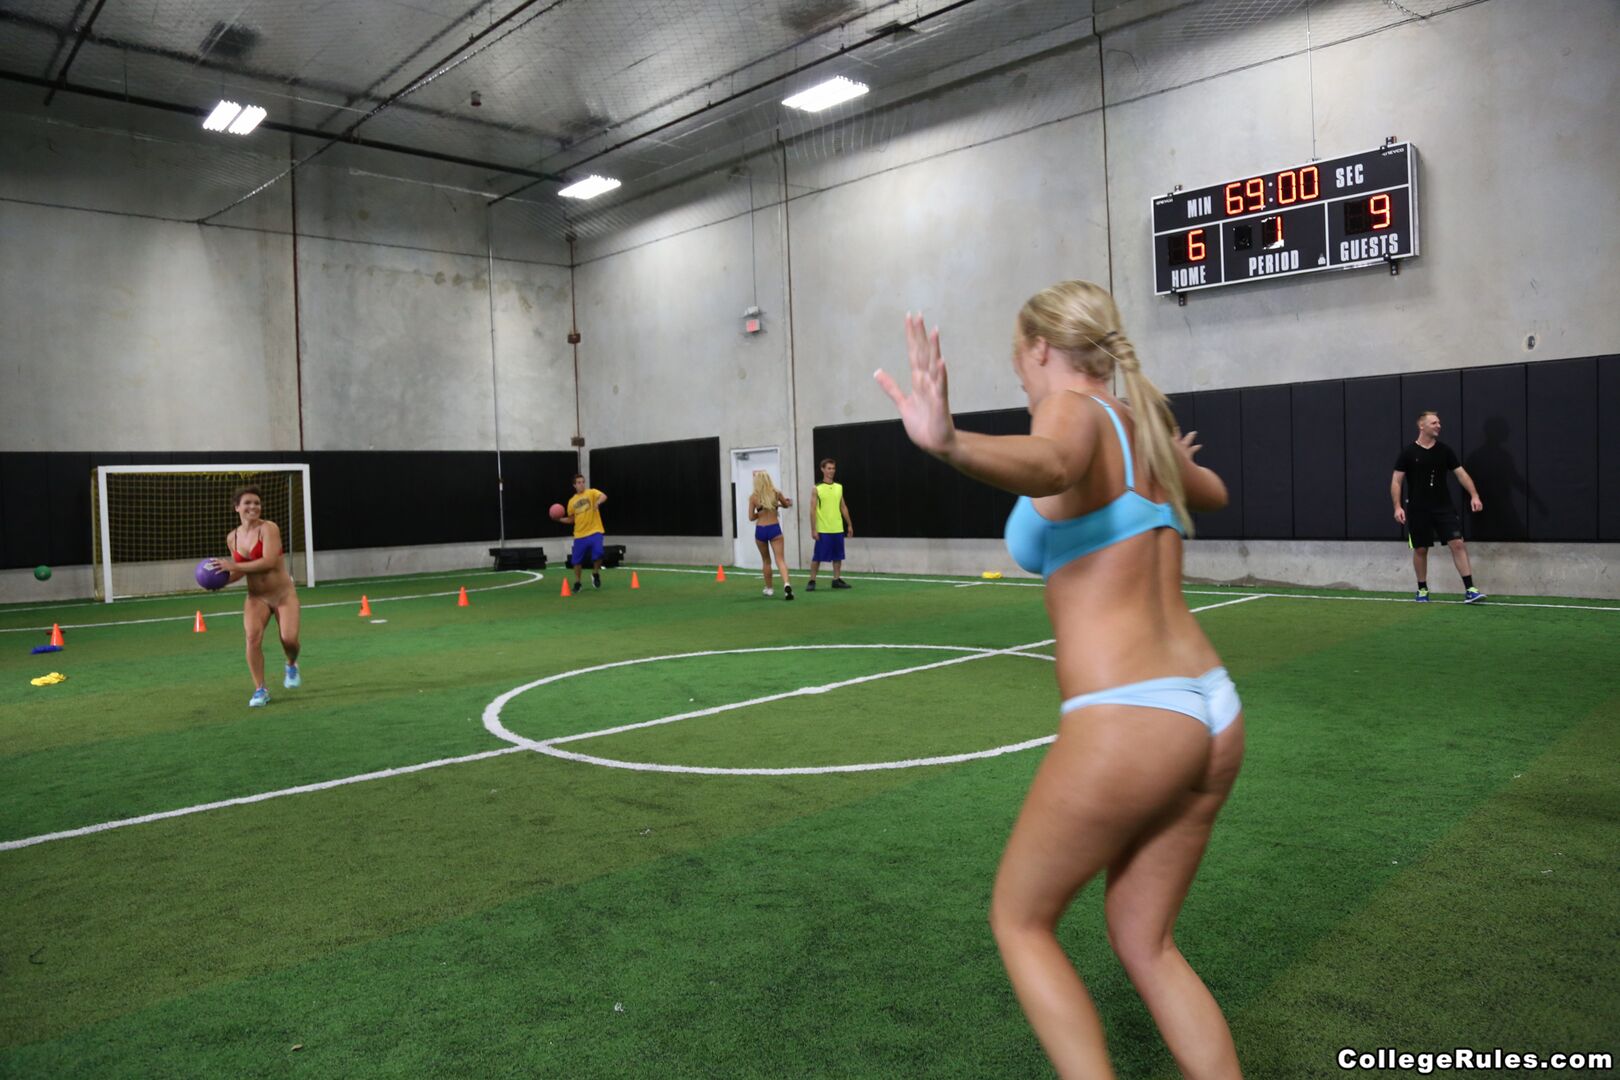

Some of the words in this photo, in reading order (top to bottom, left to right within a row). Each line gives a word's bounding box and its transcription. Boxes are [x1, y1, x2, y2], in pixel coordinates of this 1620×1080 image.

[1336, 163, 1364, 188] SEC
[1225, 166, 1319, 215] 69:00
[1187, 196, 1212, 218] MIN
[1370, 194, 1391, 229] 9
[1188, 229, 1206, 261] 6
[1340, 233, 1399, 262] GUESTS
[1171, 265, 1206, 288] HOME
[1249, 250, 1299, 276] PERIOD
